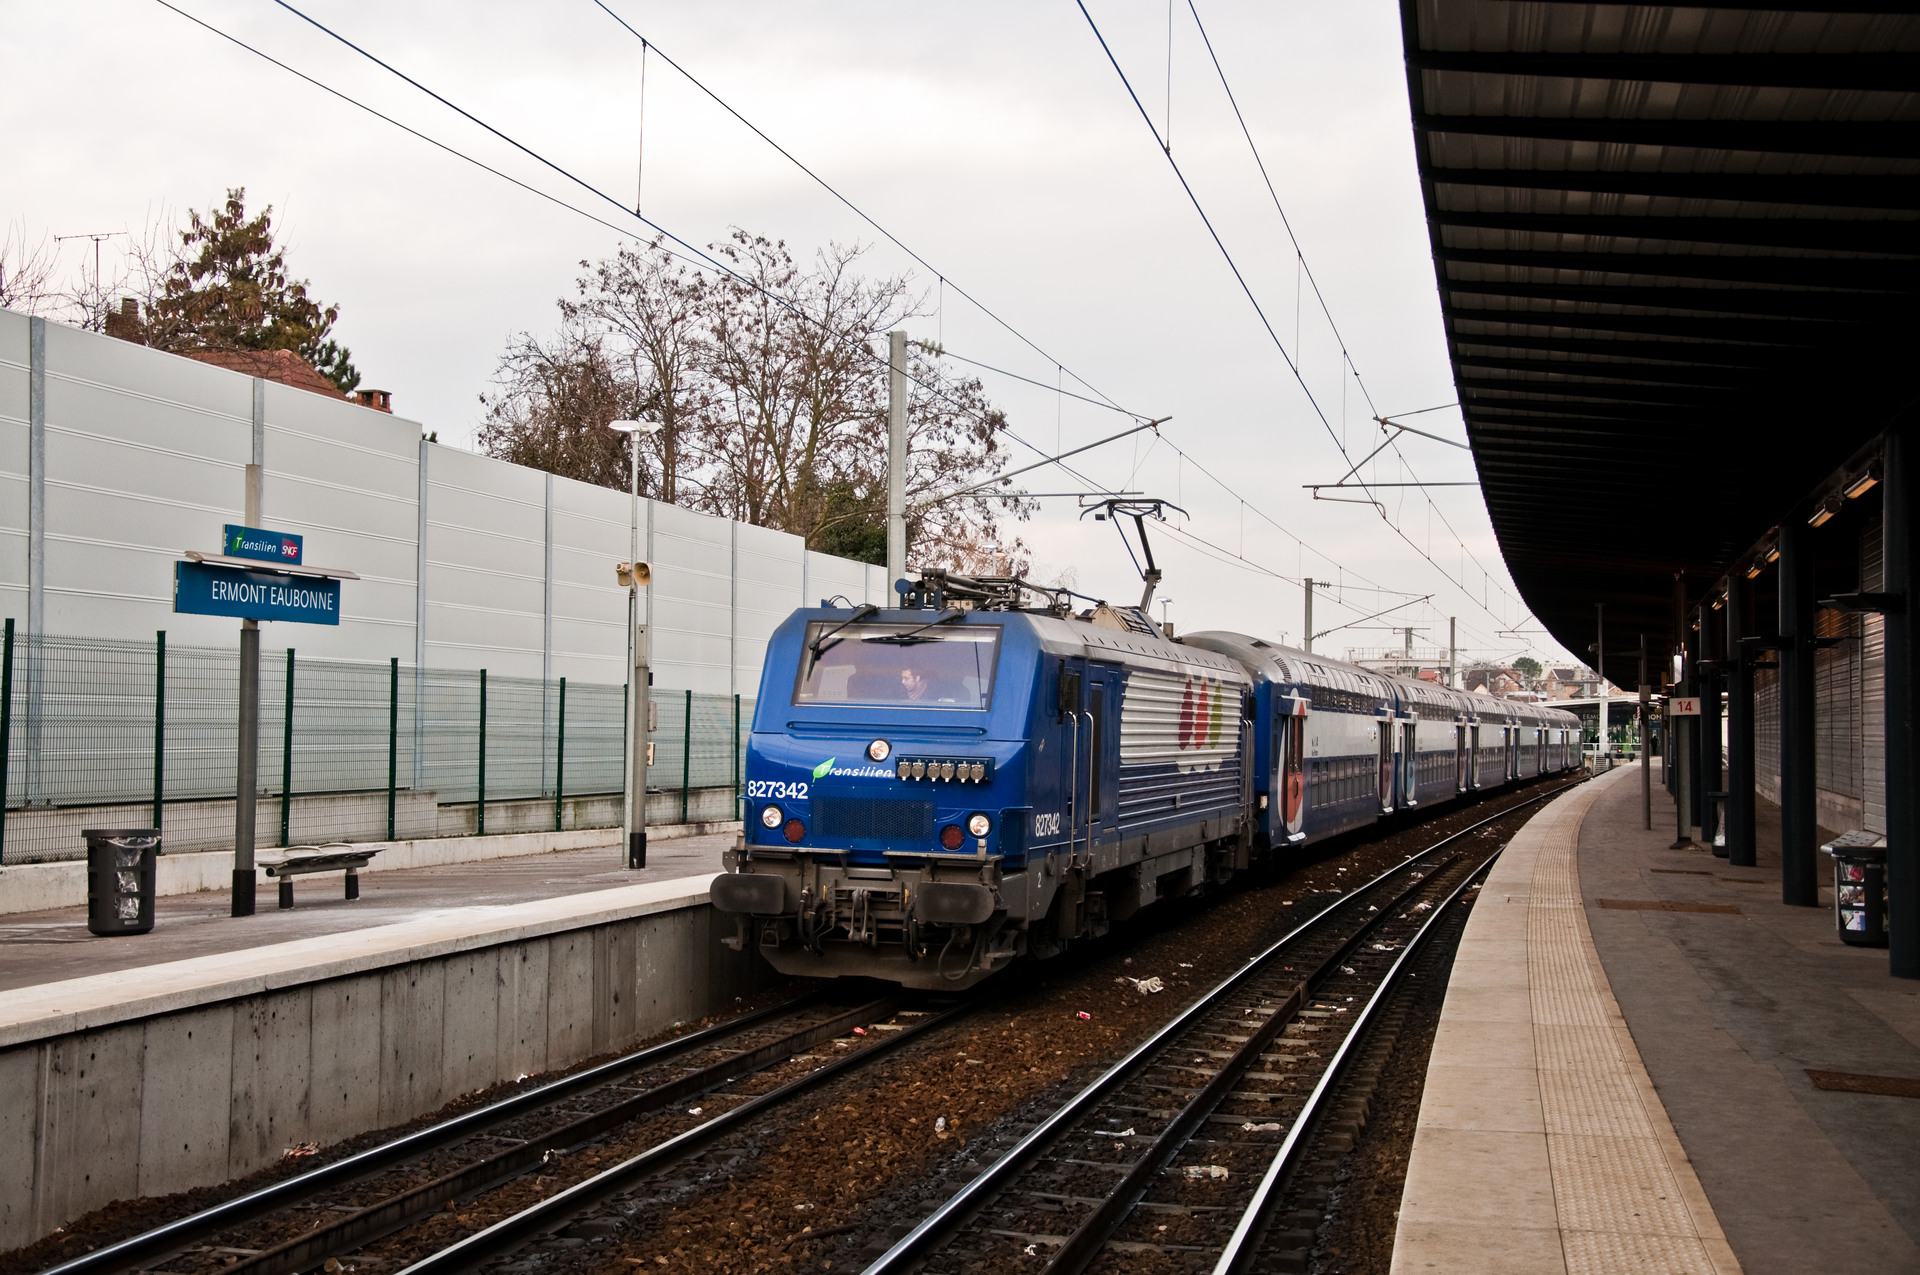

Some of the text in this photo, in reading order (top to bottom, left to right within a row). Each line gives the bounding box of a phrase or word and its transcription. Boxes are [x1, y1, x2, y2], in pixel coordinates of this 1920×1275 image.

[235, 537, 298, 556] Transilien SNCF
[212, 580, 333, 611] ERMONT EAUBONNE
[1677, 701, 1692, 712] 14
[819, 764, 893, 778] Transilien
[747, 780, 808, 800] 827342
[1035, 812, 1060, 837] 827342
[1037, 872, 1042, 888] 2
